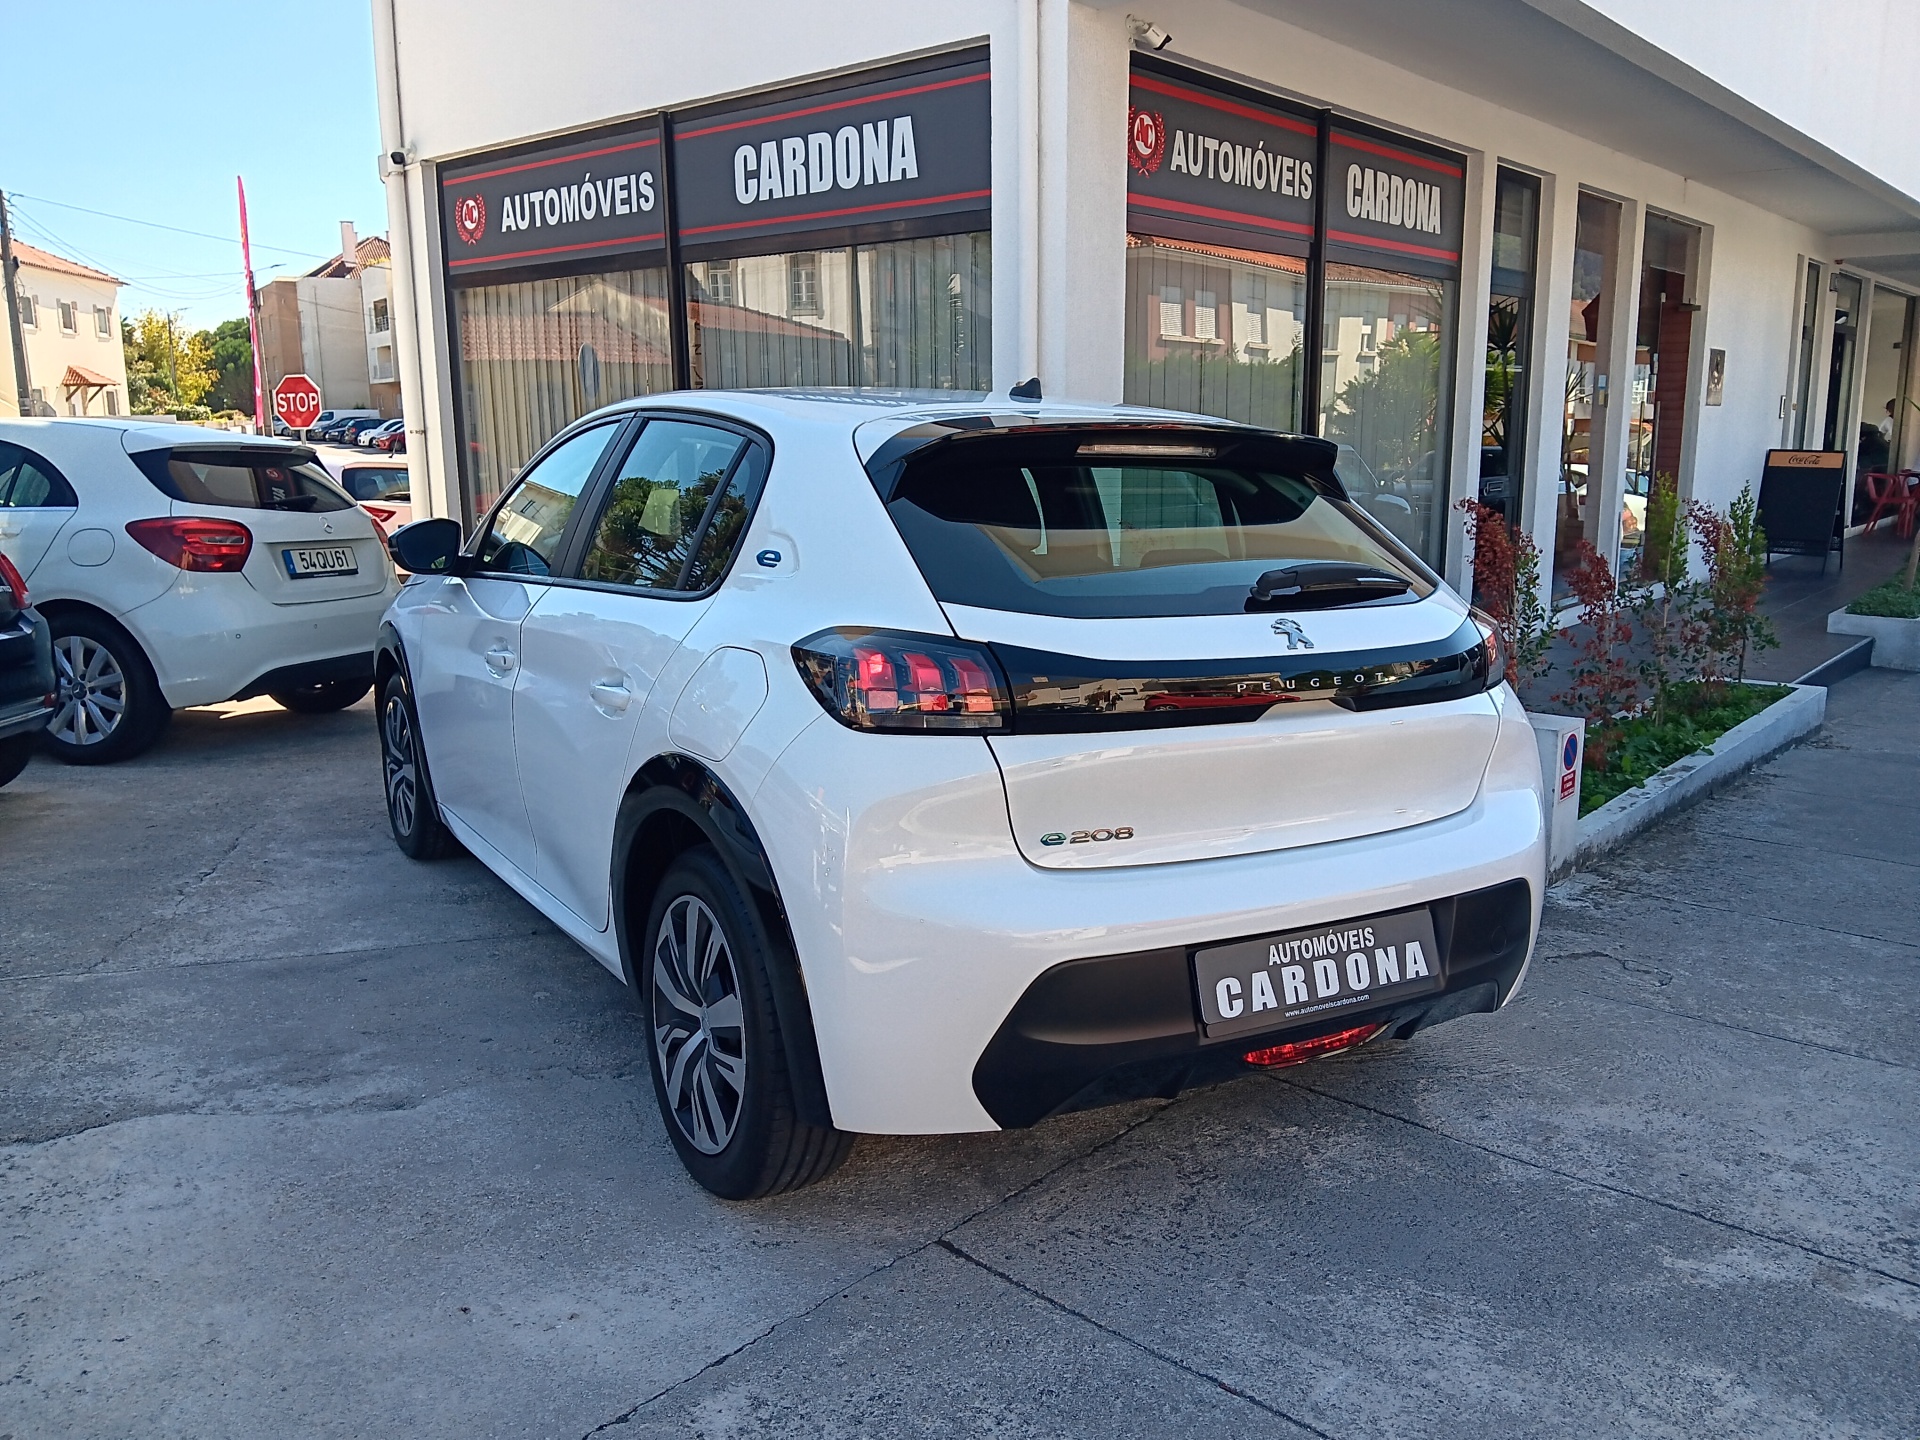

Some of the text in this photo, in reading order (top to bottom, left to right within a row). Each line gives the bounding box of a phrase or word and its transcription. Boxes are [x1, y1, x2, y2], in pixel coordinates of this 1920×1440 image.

[734, 115, 918, 205] CARDONA
[1170, 130, 1313, 200] AUTOMÓVEIS
[501, 171, 655, 233] AUTOMÓVEIS
[1346, 163, 1441, 235] CARDONA
[277, 392, 318, 413] STOP
[298, 549, 350, 570] 54QU61
[1236, 671, 1385, 693] PEUGEOT
[1268, 926, 1375, 966] AUTOMÓVEIS
[1215, 941, 1430, 1019] CARDONA
[1284, 994, 1370, 1018] www.automoveiscardona.com
